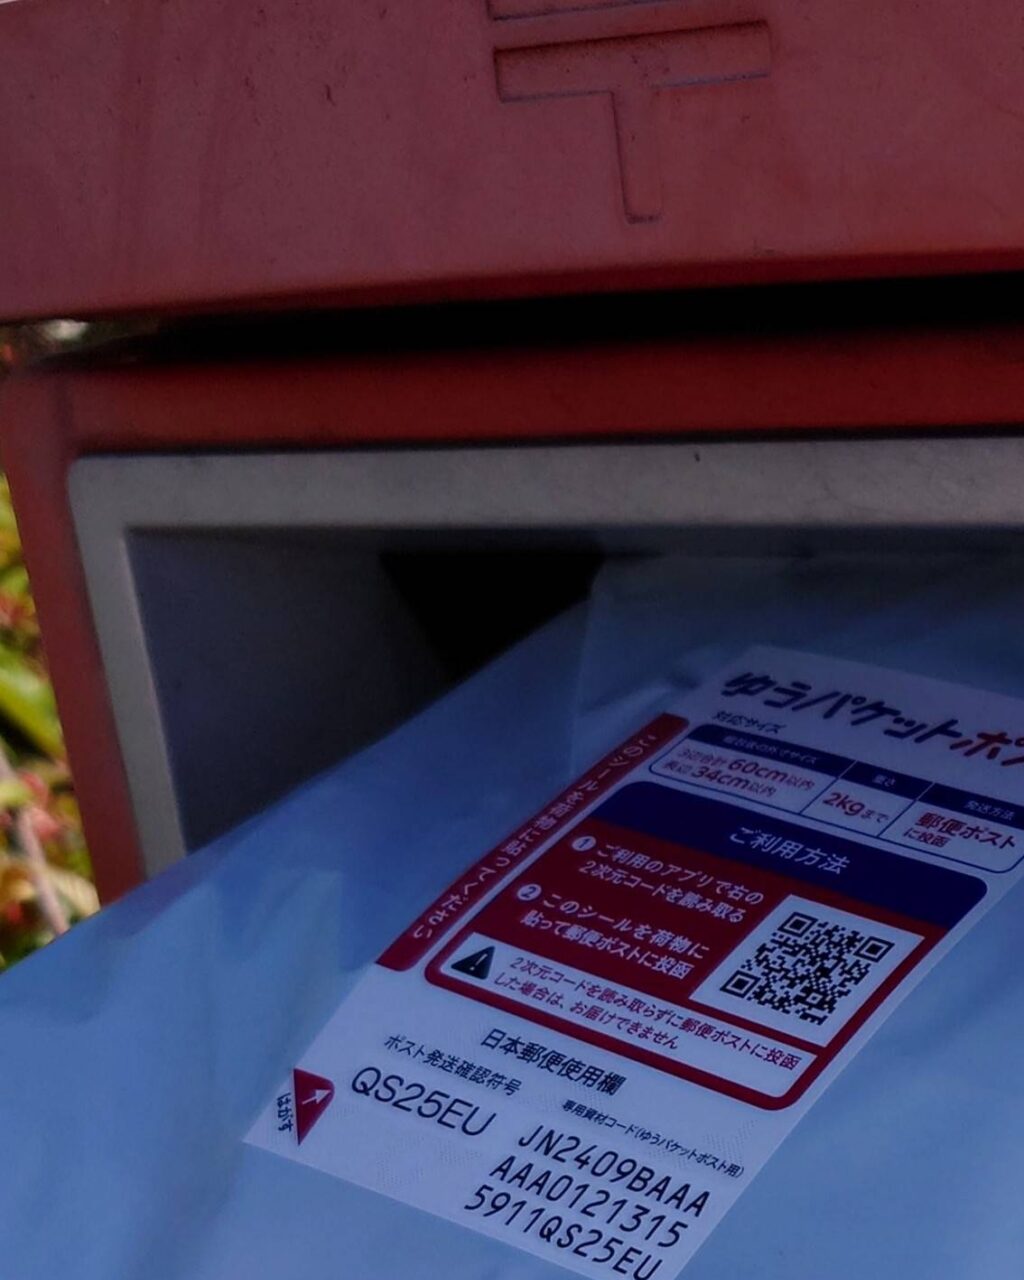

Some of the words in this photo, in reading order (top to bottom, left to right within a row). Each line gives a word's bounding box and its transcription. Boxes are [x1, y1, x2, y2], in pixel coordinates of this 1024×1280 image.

[411, 734, 657, 939] このシールを荷物に貼ってください
[729, 826, 850, 874] ご利用方法
[915, 812, 1016, 850] 郵便ポスト
[579, 860, 745, 922] 2次元コードを読み取る
[597, 844, 763, 904] ご利用のアプリで右の
[521, 910, 693, 979] 貼って郵便ポストに投函
[543, 893, 709, 958] このシールを荷物に
[494, 974, 678, 1049] した場合は、お届けできません
[510, 957, 801, 1070] 2次元コードを読み取らずに郵便ポストに投函
[384, 1036, 521, 1095] ポスト発送確認符号
[481, 1028, 625, 1095] 日本郵便使用欄
[276, 1092, 293, 1132] はがす
[351, 1067, 496, 1135] QS25EU
[489, 1155, 687, 1247] AAA0121315
[518, 1125, 709, 1216] JN2409BAAA
[464, 1184, 661, 1280] 5911QS25EU
